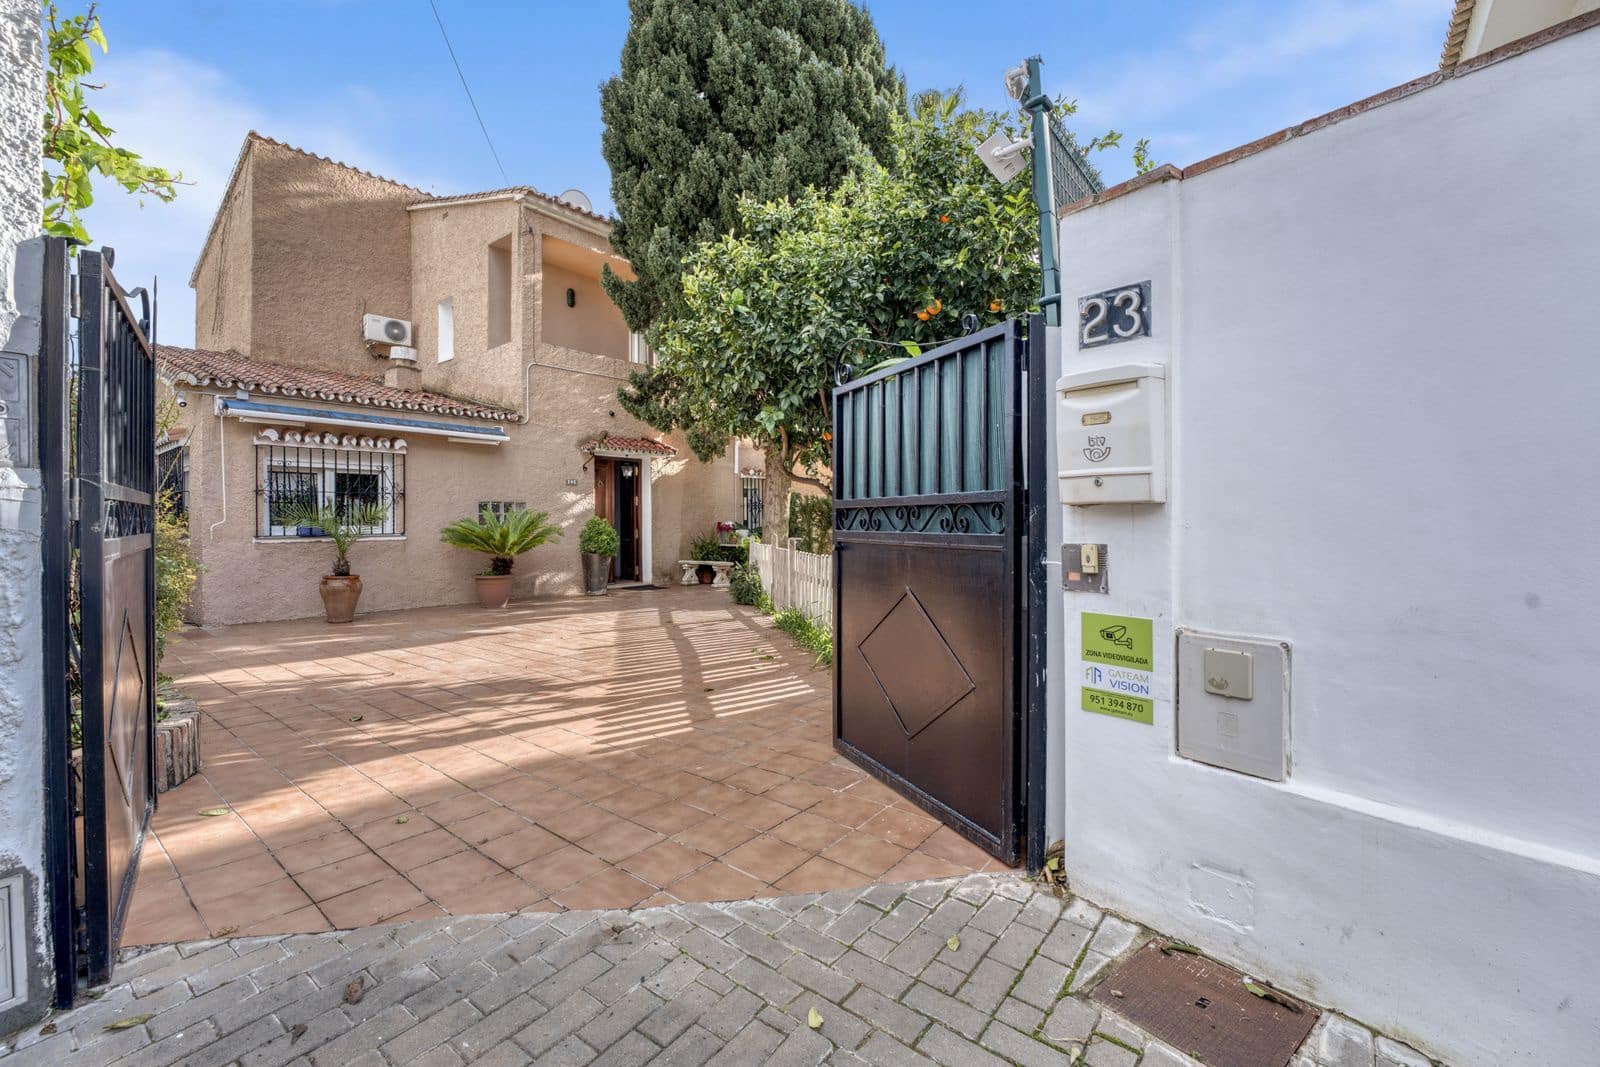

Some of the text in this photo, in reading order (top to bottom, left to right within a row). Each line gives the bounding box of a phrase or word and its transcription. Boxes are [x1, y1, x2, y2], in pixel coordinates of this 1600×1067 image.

[1081, 290, 1141, 344] 23
[1085, 649, 1149, 665] ZONA VIDEOVIGILADA
[1108, 669, 1149, 684] GATEAM
[1109, 678, 1149, 695] VISION
[1089, 694, 1105, 705] 951
[1107, 697, 1124, 709] 394
[1126, 701, 1144, 713] 870
